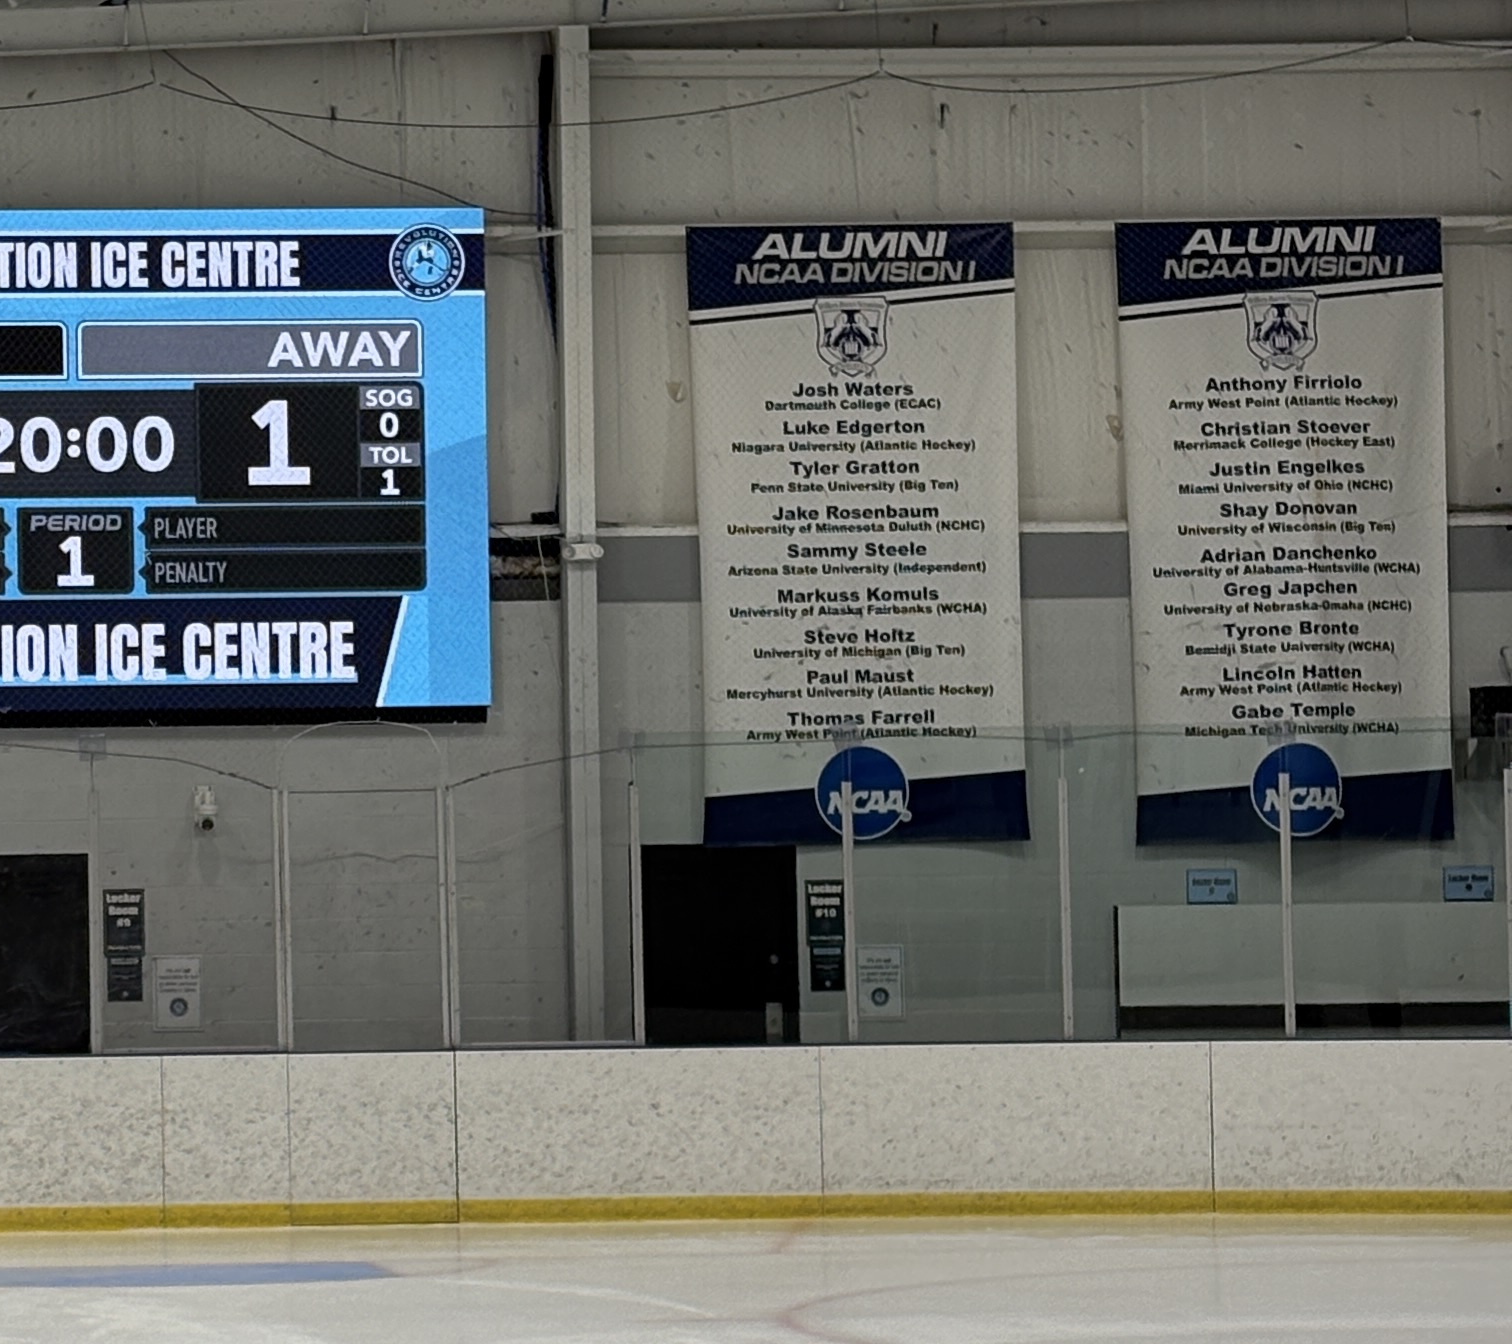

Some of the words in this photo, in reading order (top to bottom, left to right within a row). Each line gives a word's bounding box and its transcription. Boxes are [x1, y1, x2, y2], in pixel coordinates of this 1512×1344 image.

[752, 231, 947, 260] ALUMNI
[1182, 226, 1375, 256] ALUMNI
[90, 241, 149, 288] ICE
[161, 240, 301, 288] CENTRE
[734, 263, 825, 285] NCAA
[831, 261, 962, 284] DIVISION
[1163, 258, 1254, 280] NCAA
[1260, 255, 1391, 278] DIVISION
[267, 330, 411, 367] AWAY
[793, 382, 839, 397] Josh
[845, 381, 913, 397] Waters
[1206, 375, 1286, 396] Anthony
[1294, 374, 1362, 390] Firriolo
[365, 389, 413, 407] SOG
[765, 399, 836, 411] Dartmouth
[840, 399, 891, 414] College
[895, 398, 941, 413] (ECAC)
[379, 412, 399, 438] 0
[783, 419, 830, 435] Luke
[836, 418, 925, 438] Edgerton
[1201, 420, 1291, 436] Christian
[1294, 418, 1370, 434] Stoever
[248, 400, 311, 486] 1
[1174, 438, 1246, 450] Merrimack
[1250, 437, 1302, 453] College
[1306, 436, 1358, 452] (Hockey
[1363, 435, 1395, 451] East)
[369, 447, 413, 464] TOL
[790, 459, 840, 479] Tyler
[846, 458, 919, 474] Gratton
[1209, 460, 1270, 476] Justin
[1277, 458, 1364, 479] Engelkes
[380, 469, 400, 495] 1
[773, 505, 819, 521] Jake
[826, 503, 939, 520] Rosenbaum
[1220, 501, 1268, 521] Shay
[1274, 500, 1357, 516] Donovan
[29, 515, 122, 532] PERIOD
[154, 517, 217, 539] PLAYER
[57, 536, 95, 587] 1
[787, 542, 858, 562] Sammy
[865, 541, 927, 557] Steele
[1201, 547, 1265, 563] Adrian
[1273, 545, 1377, 561] Danchenko
[154, 561, 227, 583] PENALTY
[778, 587, 860, 603] Markuss
[867, 586, 939, 602] Komuls
[1224, 581, 1272, 600] Greg
[1275, 580, 1357, 600] Japchen
[804, 628, 858, 644] Steve
[865, 628, 915, 643] Holtz
[1223, 621, 1292, 641] Tyrone
[1298, 620, 1359, 636] Bronte
[95, 623, 167, 681] ICE
[183, 621, 355, 681] CENTRE
[807, 668, 848, 684] Paul
[854, 667, 914, 683] Maust
[1223, 665, 1295, 681] Lincoln
[1299, 664, 1362, 680] Hatten
[787, 709, 865, 726] Thomas
[871, 708, 935, 724] Farrell
[1232, 702, 1283, 718] Gabe
[1290, 701, 1355, 721] Temple
